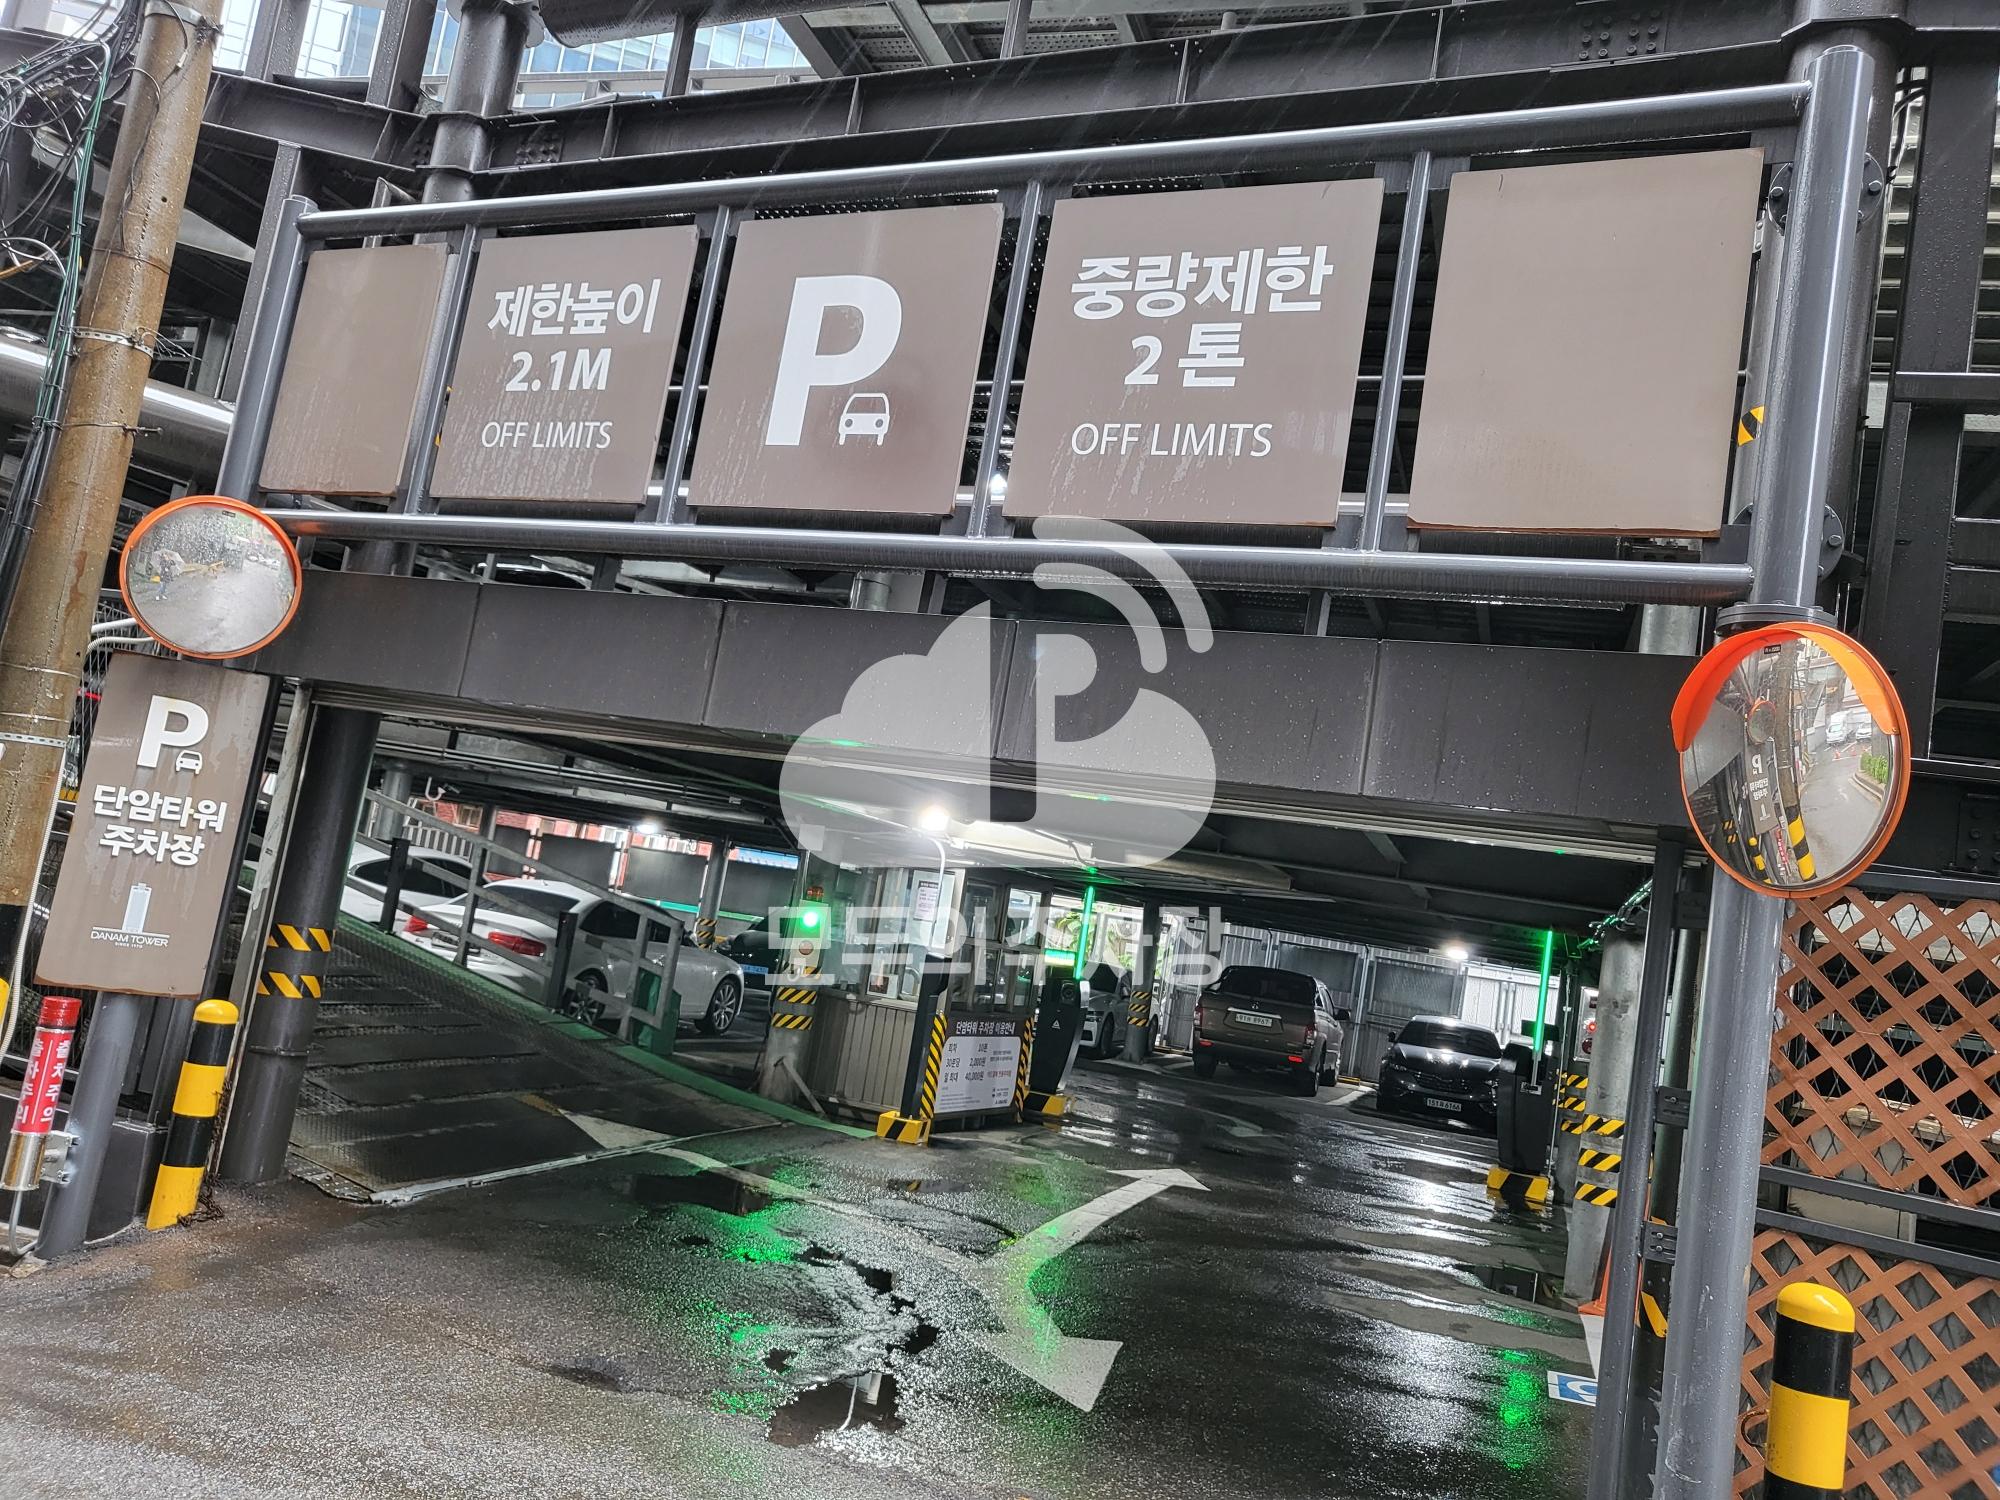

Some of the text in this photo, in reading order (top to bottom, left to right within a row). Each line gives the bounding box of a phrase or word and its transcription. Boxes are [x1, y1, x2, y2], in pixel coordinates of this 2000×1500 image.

[1071, 245, 1334, 320] 중량제한
[487, 278, 661, 337] 제한높이
[505, 348, 612, 392] 2.1M
[765, 275, 902, 446] P
[1124, 322, 1245, 388] 2 톤
[481, 421, 613, 449] OFF LIMITS
[1071, 423, 1273, 457] OFF LIMITS
[137, 694, 209, 768] P
[94, 784, 228, 833] 단암타워
[100, 824, 206, 866] 주차장
[90, 930, 169, 947] DANAM TOWER
